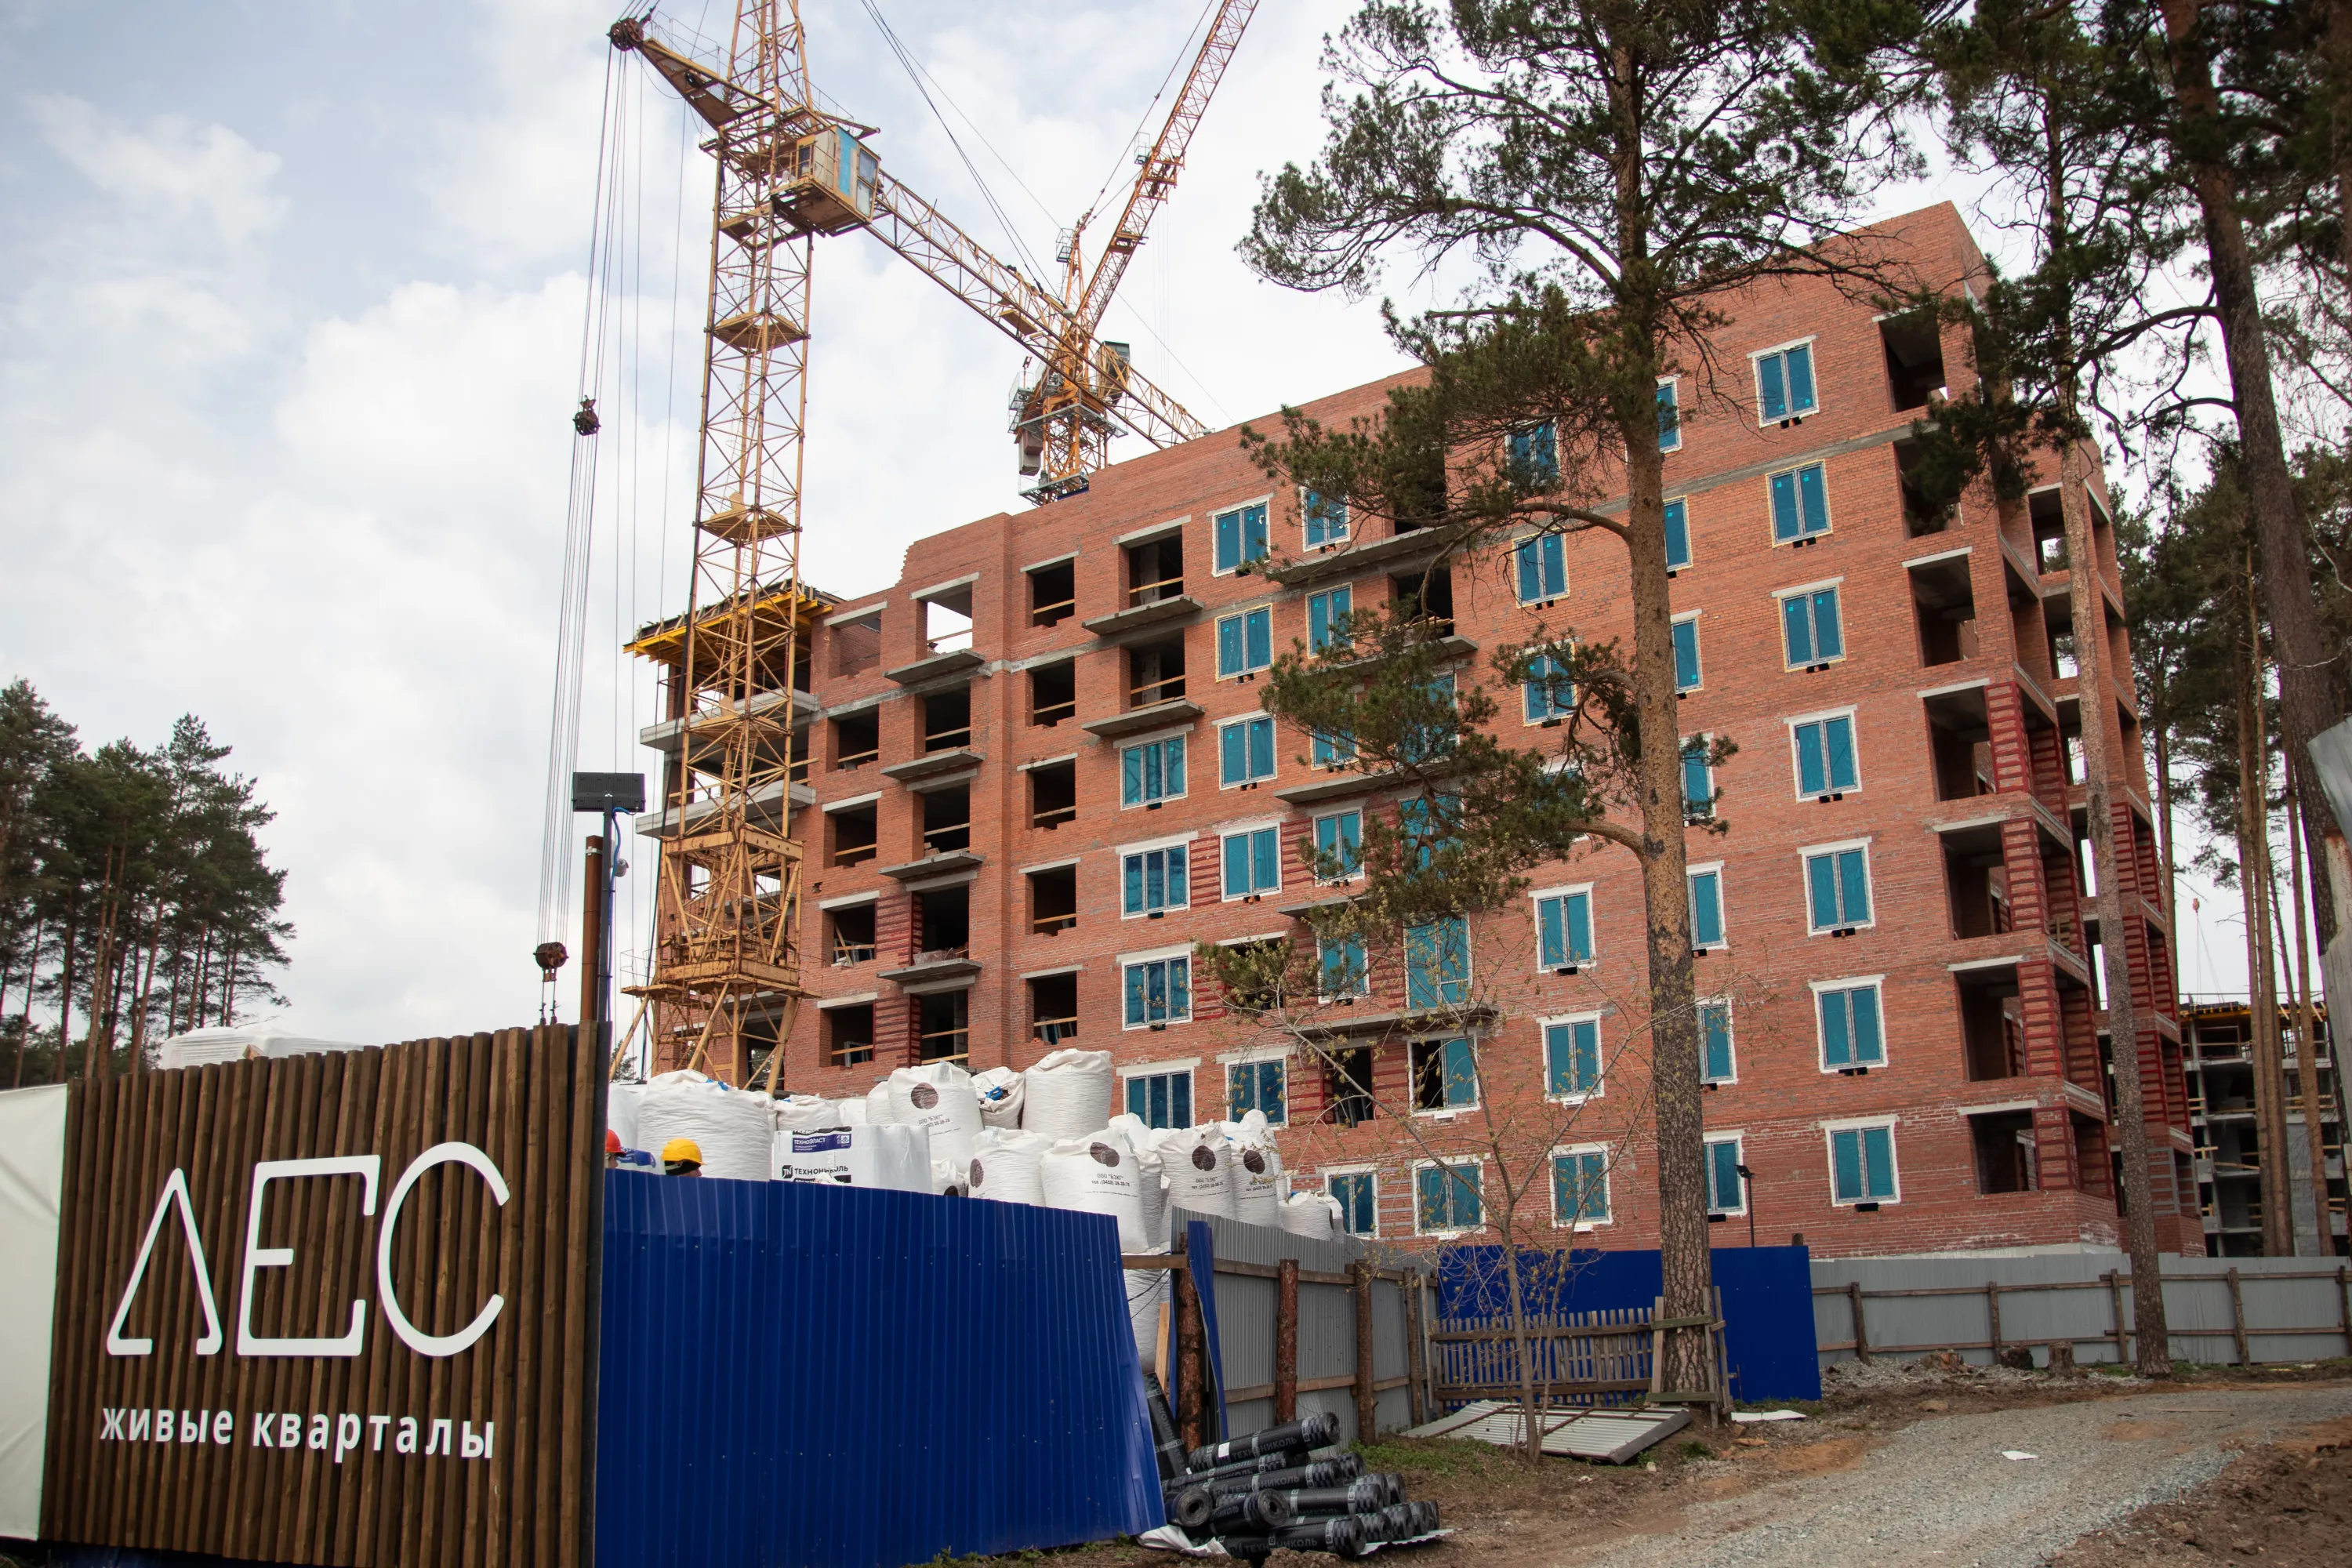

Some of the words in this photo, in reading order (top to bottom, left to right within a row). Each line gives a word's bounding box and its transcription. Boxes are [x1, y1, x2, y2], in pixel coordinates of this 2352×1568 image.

[106, 1142, 510, 1357] ЛЕС
[100, 1407, 233, 1445] живые
[252, 1412, 495, 1464] кварталы
[1156, 1401, 1186, 1468] ТЕХННИКОЛЬ
[1232, 1436, 1298, 1460] ТЕХННИКОЛЬ
[1230, 1475, 1301, 1494] ТЕХННИКОЛЬ
[1243, 1538, 1318, 1553] ТЕХННИКОЛЬ
